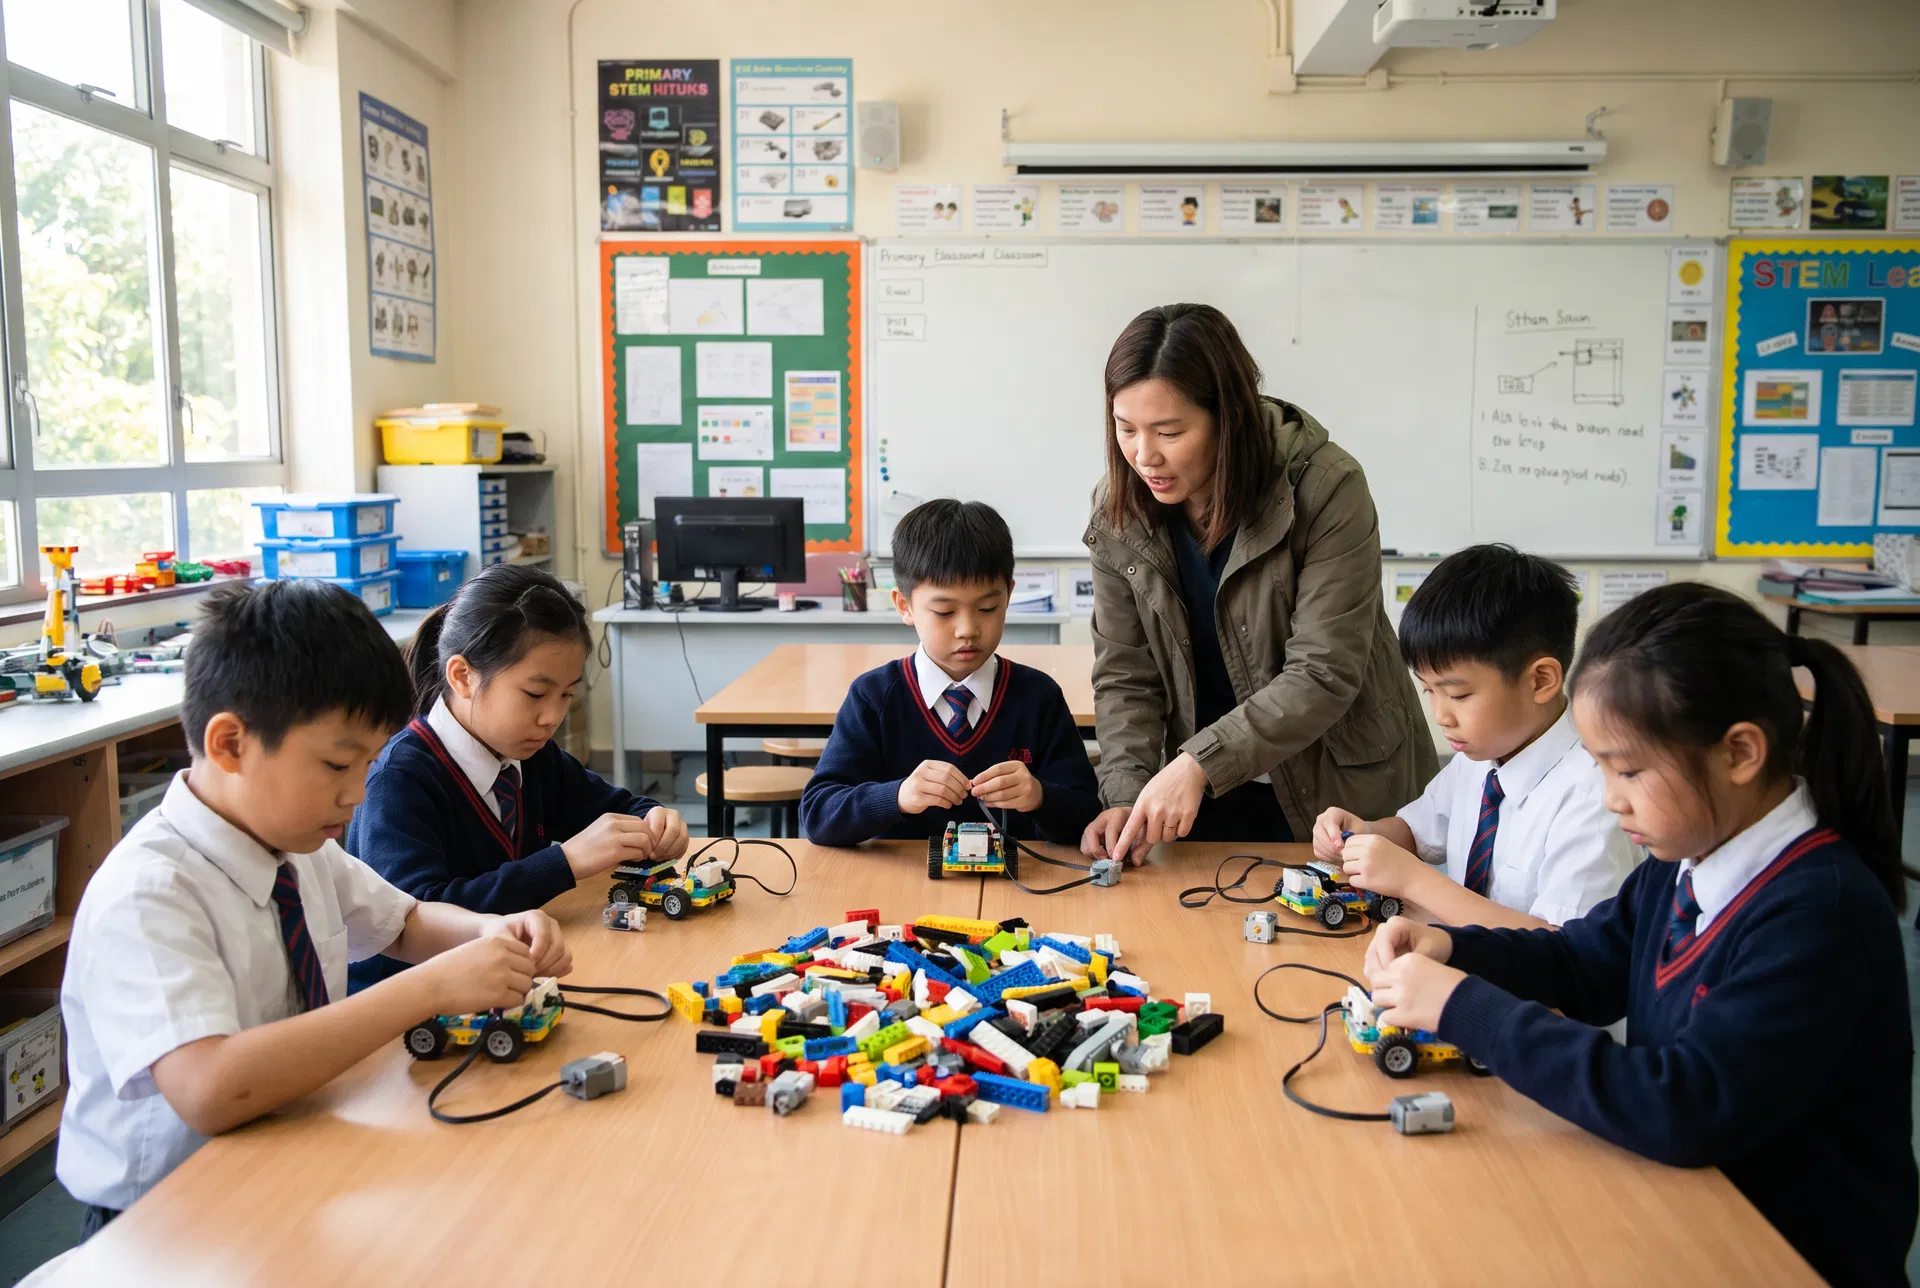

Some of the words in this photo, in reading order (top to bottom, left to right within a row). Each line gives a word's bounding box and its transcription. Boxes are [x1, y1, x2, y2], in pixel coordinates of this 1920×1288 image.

[625, 68, 692, 81] PRIMARY
[609, 83, 652, 96] STEM
[880, 248, 926, 268] Primary
[1754, 259, 1849, 289] STEM
[1867, 260, 1920, 289] Lea
